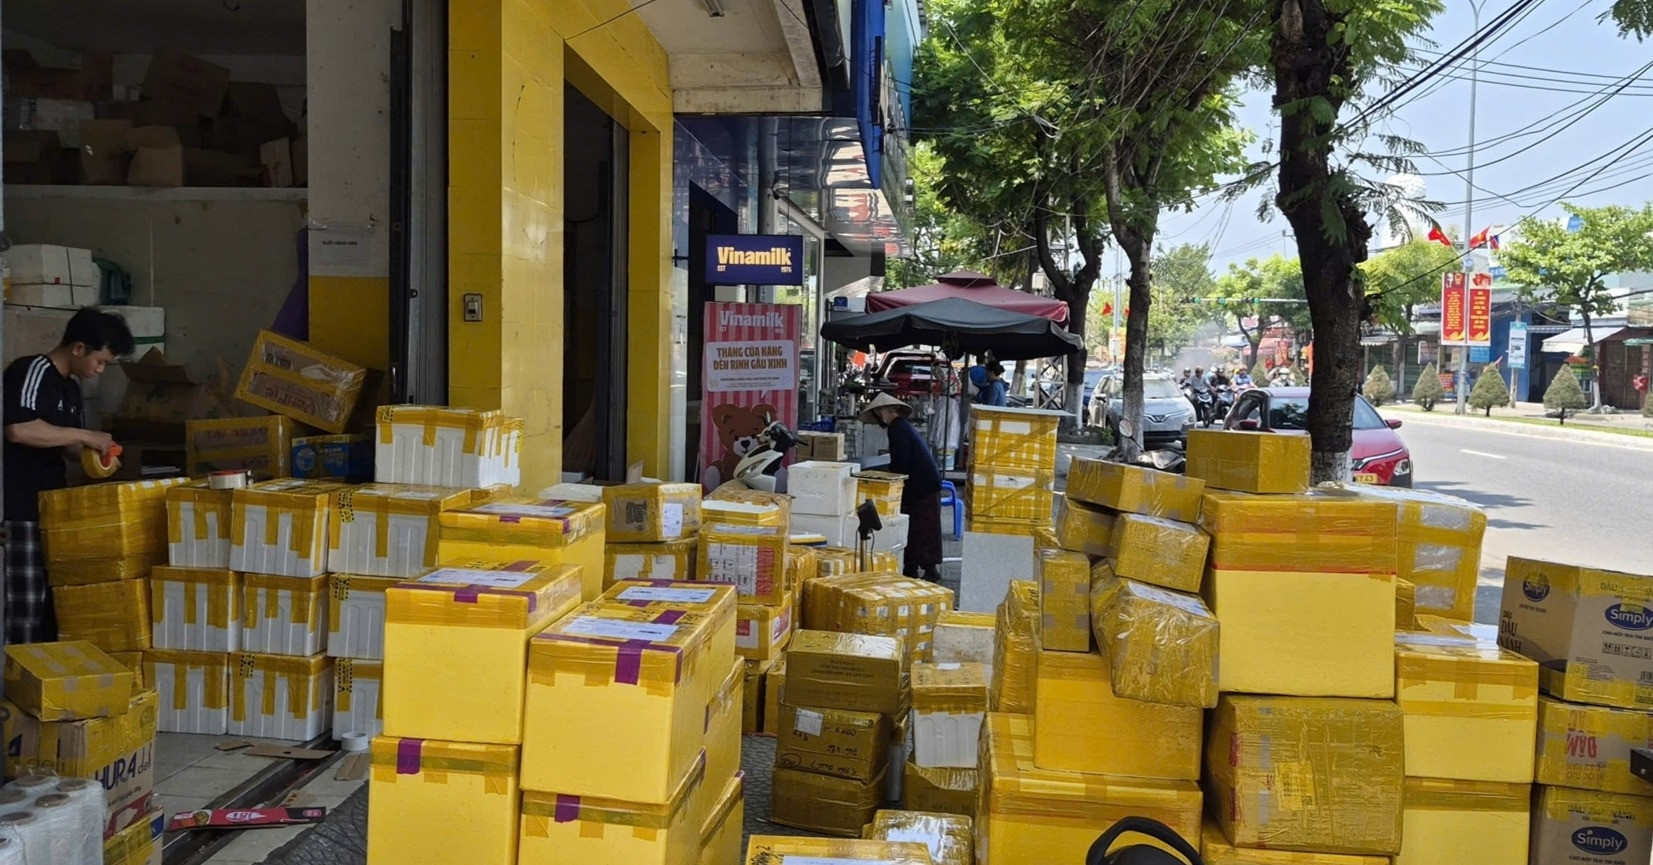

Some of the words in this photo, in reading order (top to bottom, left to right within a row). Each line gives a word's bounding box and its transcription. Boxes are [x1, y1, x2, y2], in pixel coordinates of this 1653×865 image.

[716, 246, 792, 265] Vinamilk
[720, 310, 784, 328] Vinamilk
[768, 358, 787, 369] XINH
[1610, 608, 1653, 626] Simply
[1577, 829, 1623, 850] Simply
